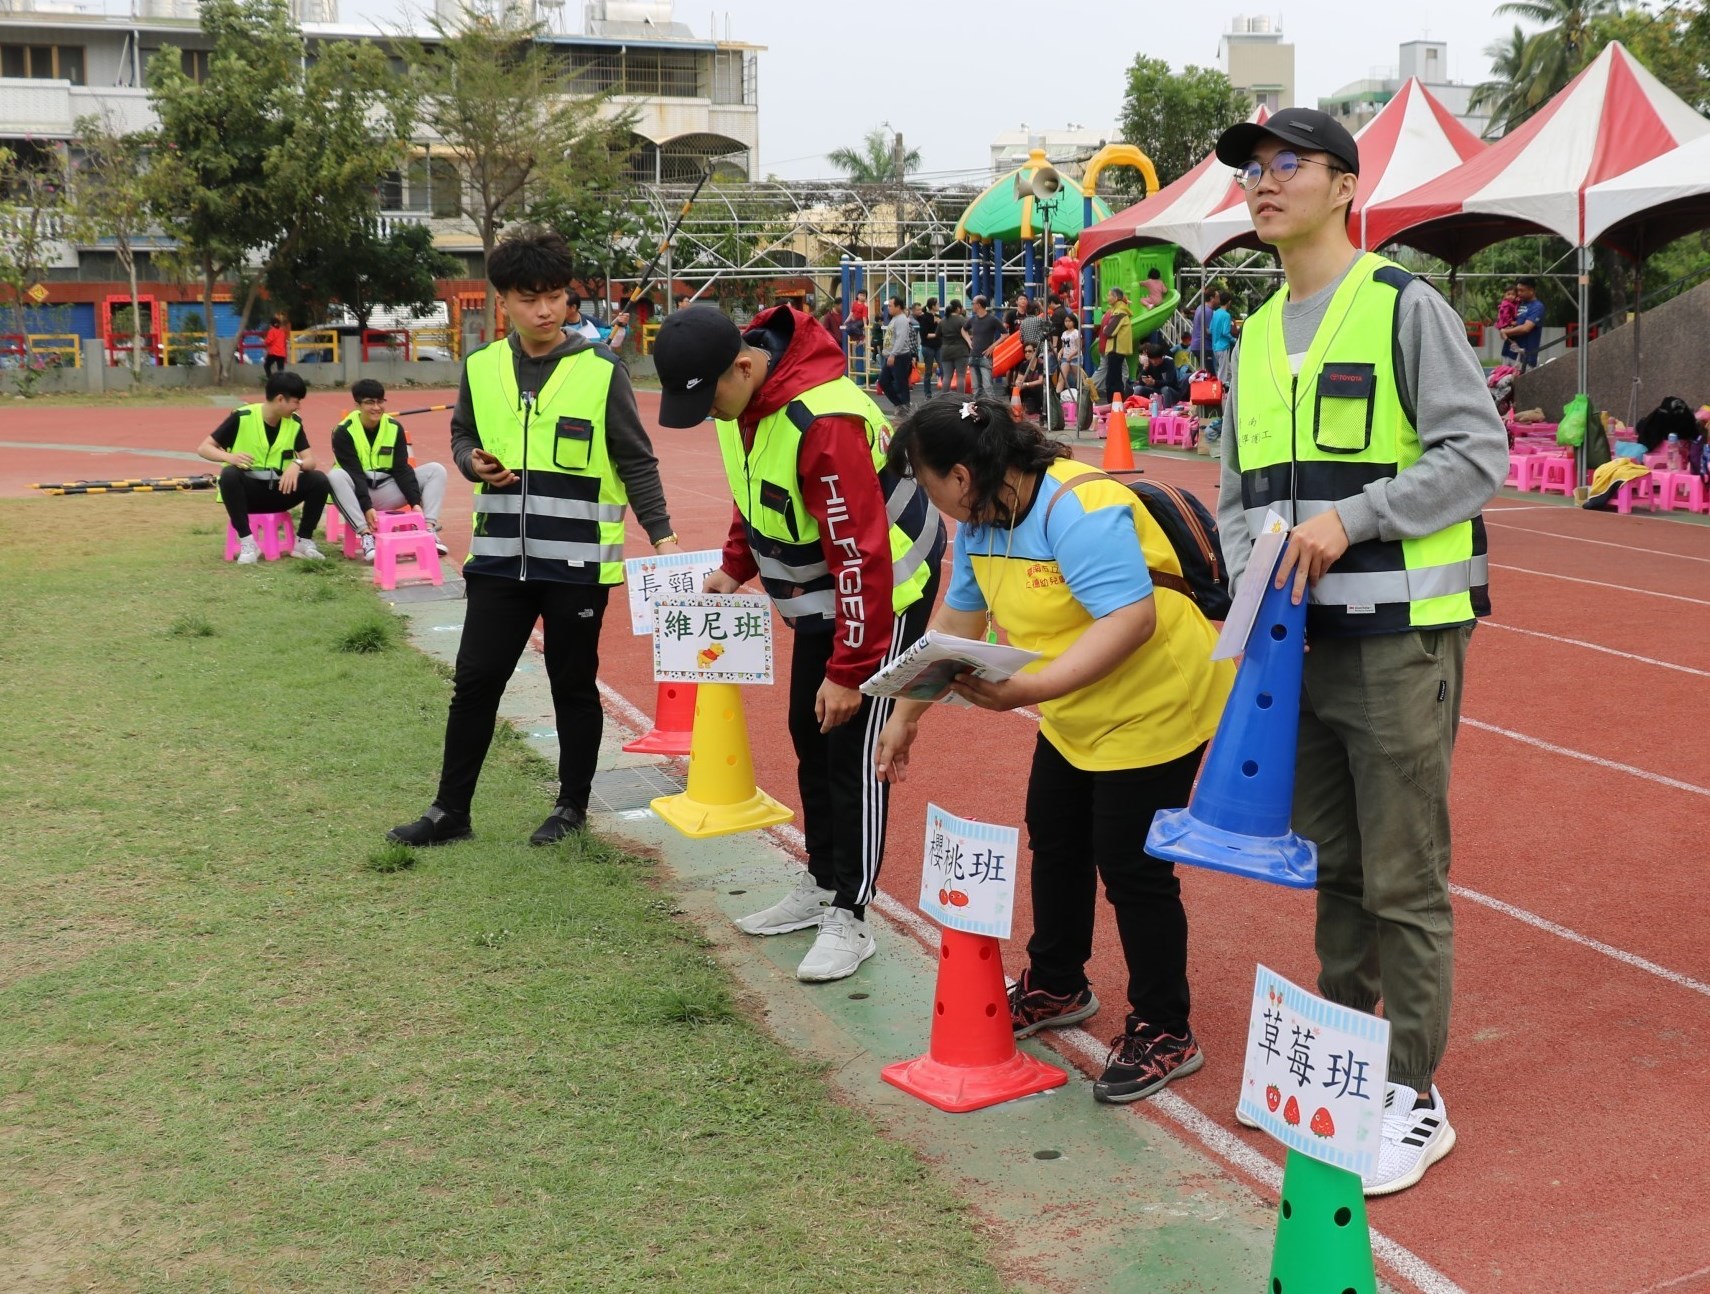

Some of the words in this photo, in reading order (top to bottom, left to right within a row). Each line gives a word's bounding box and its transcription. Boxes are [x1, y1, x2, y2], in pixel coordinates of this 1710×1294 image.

[1339, 374, 1363, 383] TOYOTA
[820, 474, 866, 649] HILFIGER
[638, 567, 718, 602] 長頸
[664, 609, 765, 642] 維尼班
[928, 829, 1007, 885] 櫻桃班
[1257, 1007, 1371, 1101] 草莓班
